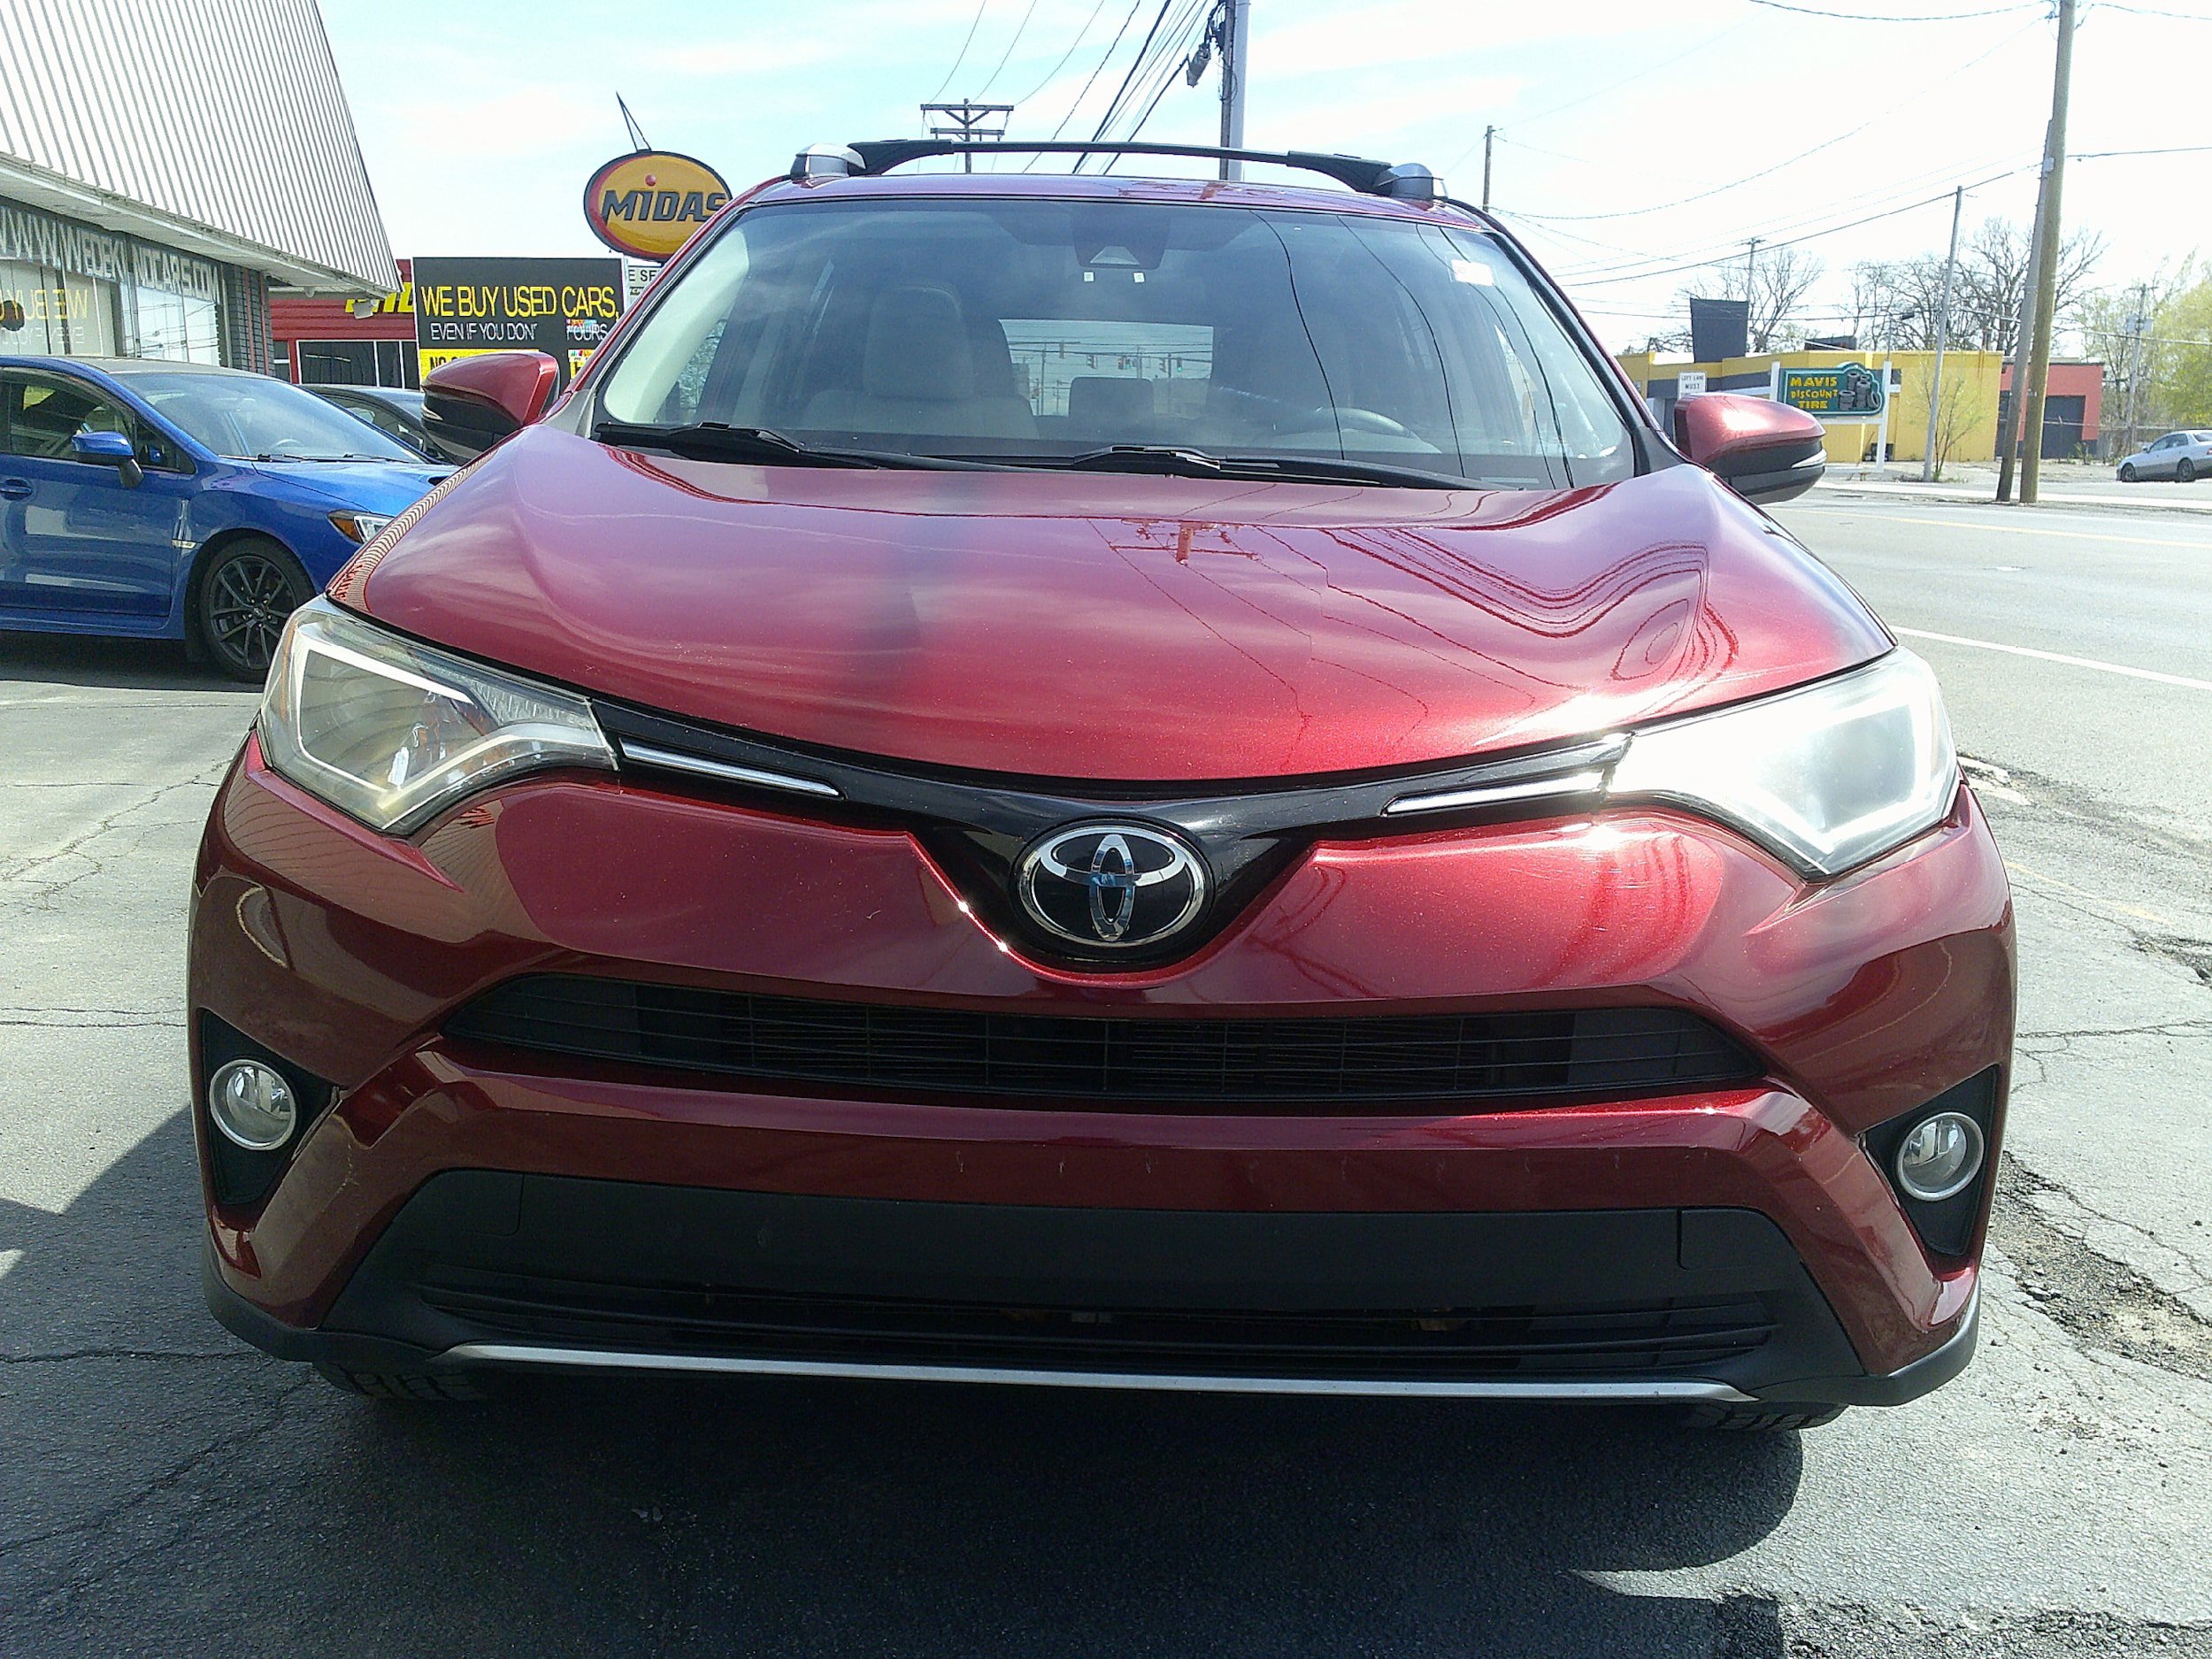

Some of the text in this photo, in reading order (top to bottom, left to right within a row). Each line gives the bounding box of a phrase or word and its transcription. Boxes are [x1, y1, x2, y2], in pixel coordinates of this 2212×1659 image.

[601, 189, 727, 226] MIDAS
[421, 286, 455, 317] WE
[457, 286, 498, 318] BUY
[503, 286, 557, 318] USED
[430, 322, 465, 341] EVEN
[467, 322, 478, 341] IF
[479, 322, 504, 342] YOU
[1789, 376, 1838, 388] MAVIS
[1790, 389, 1839, 399] DISCOUNT
[1797, 400, 1828, 410] TIRE
